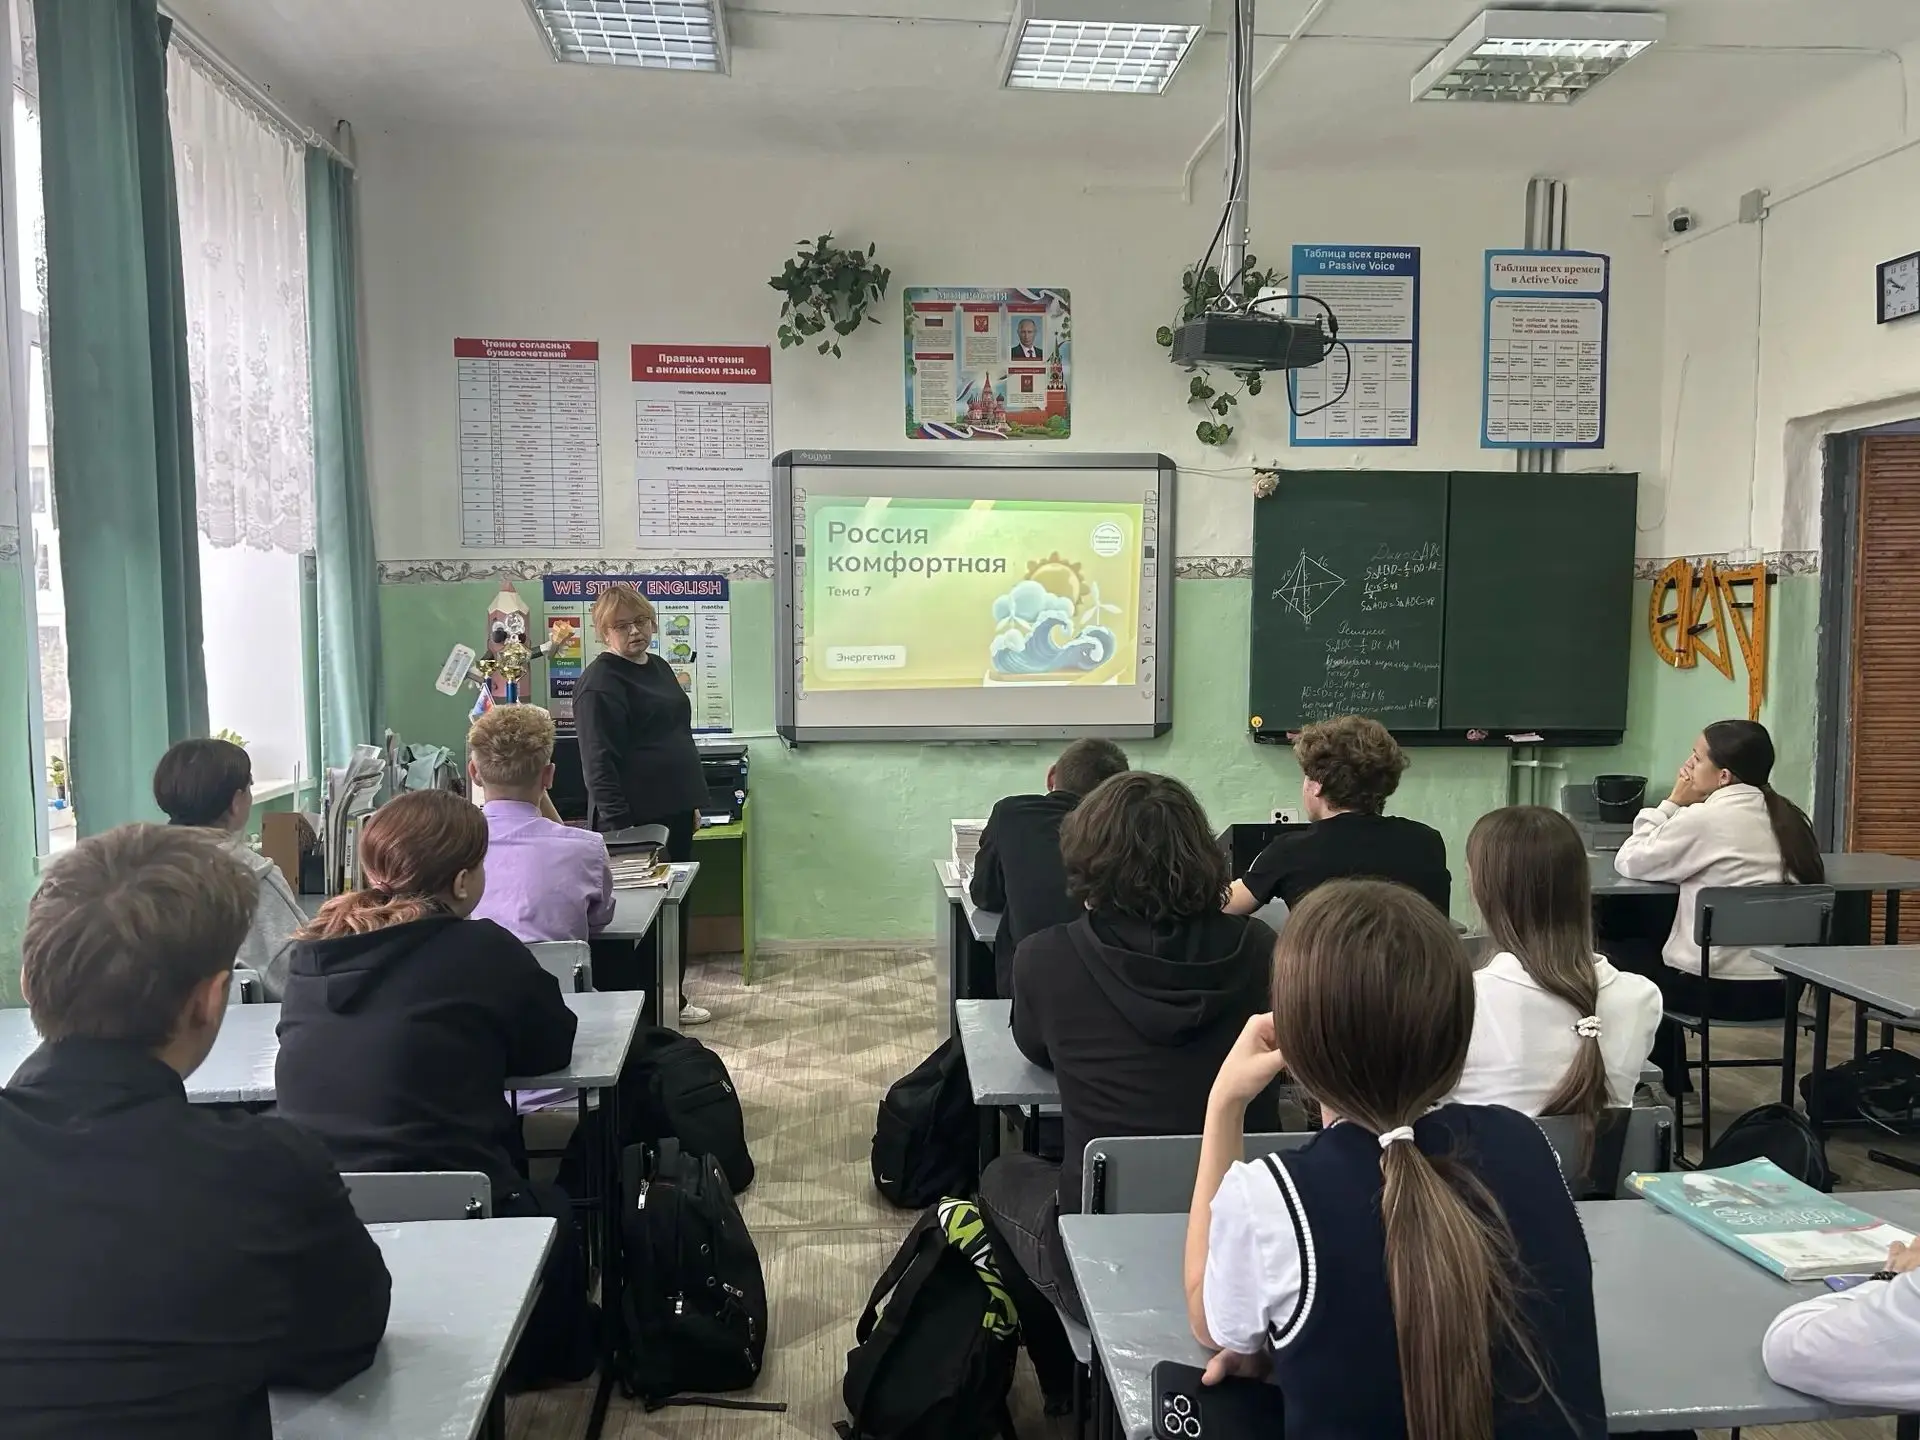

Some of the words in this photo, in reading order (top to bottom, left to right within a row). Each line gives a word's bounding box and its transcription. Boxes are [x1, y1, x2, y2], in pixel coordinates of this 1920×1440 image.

[1303, 248, 1346, 259] Таблица
[1349, 251, 1372, 259] всех
[1374, 251, 1411, 260] времен
[1319, 262, 1326, 270] в
[1328, 261, 1366, 270] Passive
[1369, 261, 1395, 271] Voice
[1493, 263, 1538, 273] Таблица
[1564, 266, 1600, 274] времен
[1518, 275, 1549, 284] Active
[1551, 275, 1578, 285] Voice
[481, 339, 517, 348] Чтение
[520, 341, 571, 350] согласных
[486, 348, 567, 358] буквосочетаний
[658, 354, 705, 364] Правила
[707, 355, 744, 364] чтения
[646, 366, 653, 374] в
[656, 365, 720, 375] английском
[722, 367, 757, 376] языке
[828, 521, 928, 544] Россия
[828, 550, 1006, 578] комфортная
[552, 581, 581, 595] WE
[647, 581, 722, 595] ENGLISH
[827, 586, 860, 597] Тема
[864, 586, 871, 597] 7
[836, 653, 896, 664] Энергетика
